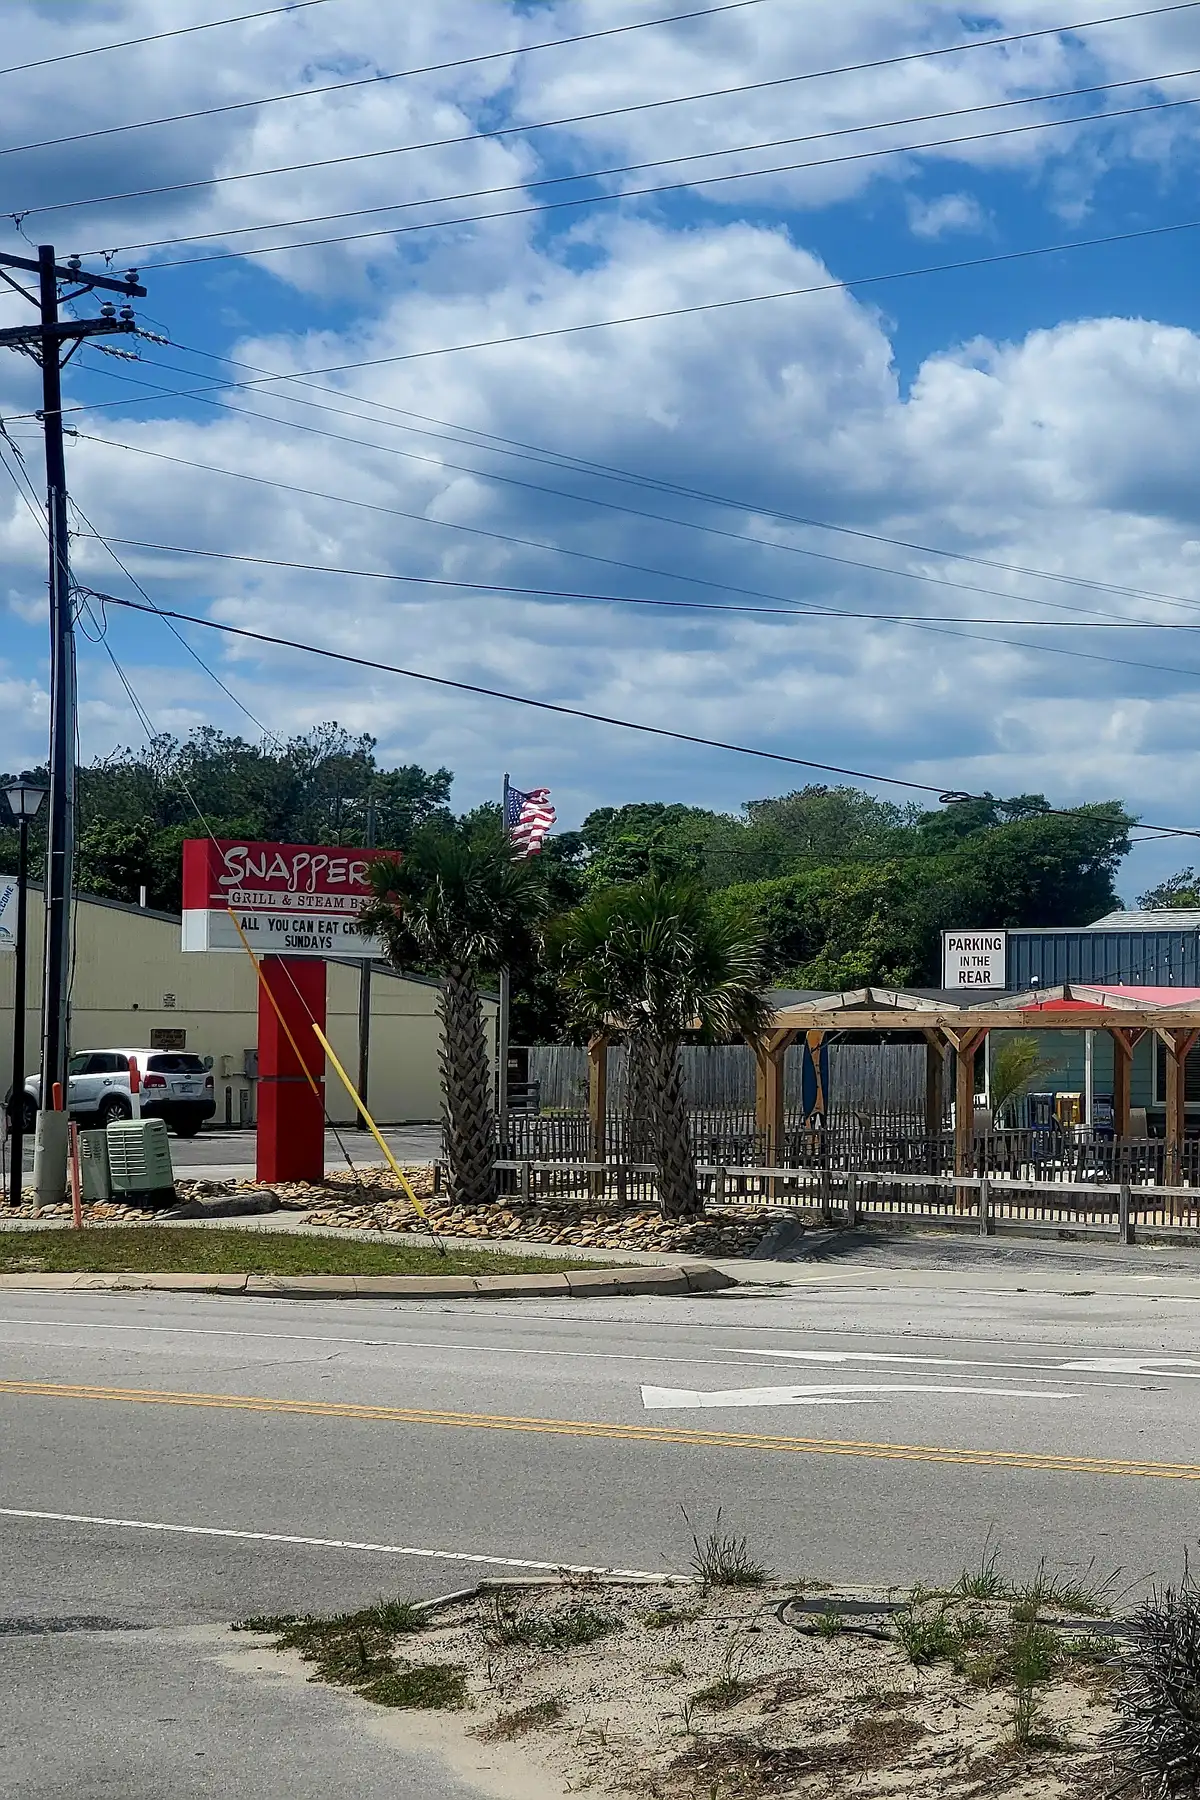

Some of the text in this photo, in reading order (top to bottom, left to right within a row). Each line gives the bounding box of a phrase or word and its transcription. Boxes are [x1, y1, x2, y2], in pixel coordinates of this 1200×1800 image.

[232, 891, 276, 905] GRILL
[282, 895, 292, 906] &
[297, 896, 344, 908] STEAM
[241, 917, 260, 931] ALL
[268, 918, 289, 932] YOU
[292, 919, 314, 933] CAN
[318, 920, 339, 934] EAT
[285, 934, 332, 949] SUNDAYS
[948, 937, 1002, 951] PARKING
[960, 955, 990, 967] IN THE
[958, 970, 991, 984] REAR
